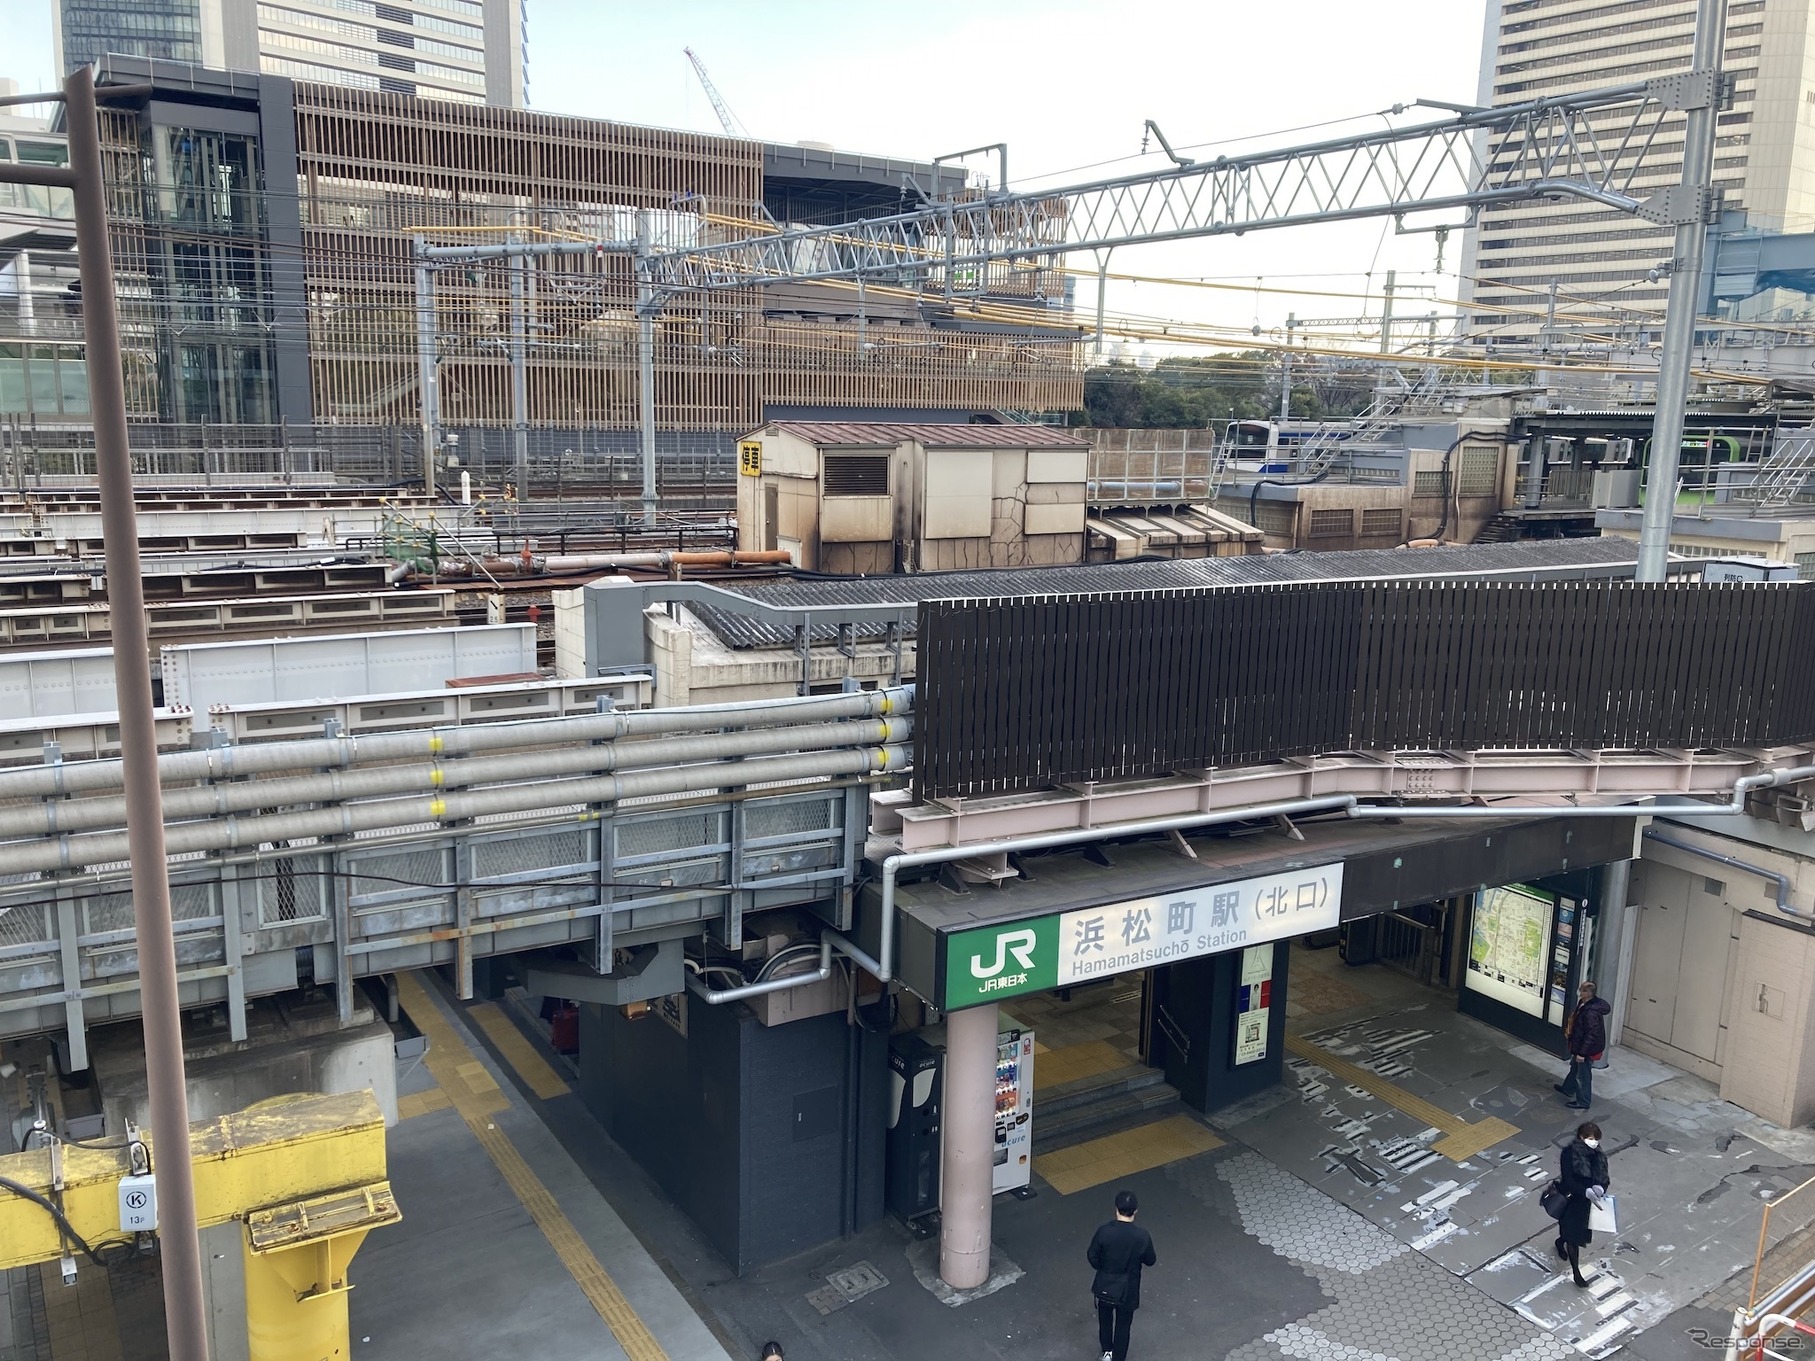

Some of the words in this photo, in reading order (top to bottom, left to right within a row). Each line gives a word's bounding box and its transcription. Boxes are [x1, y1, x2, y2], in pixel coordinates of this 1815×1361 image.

[970, 928, 1037, 979] JR
[1072, 939, 1190, 976] Hamamatsuchō
[1197, 929, 1247, 950] Station
[978, 972, 1028, 993] JR東日本
